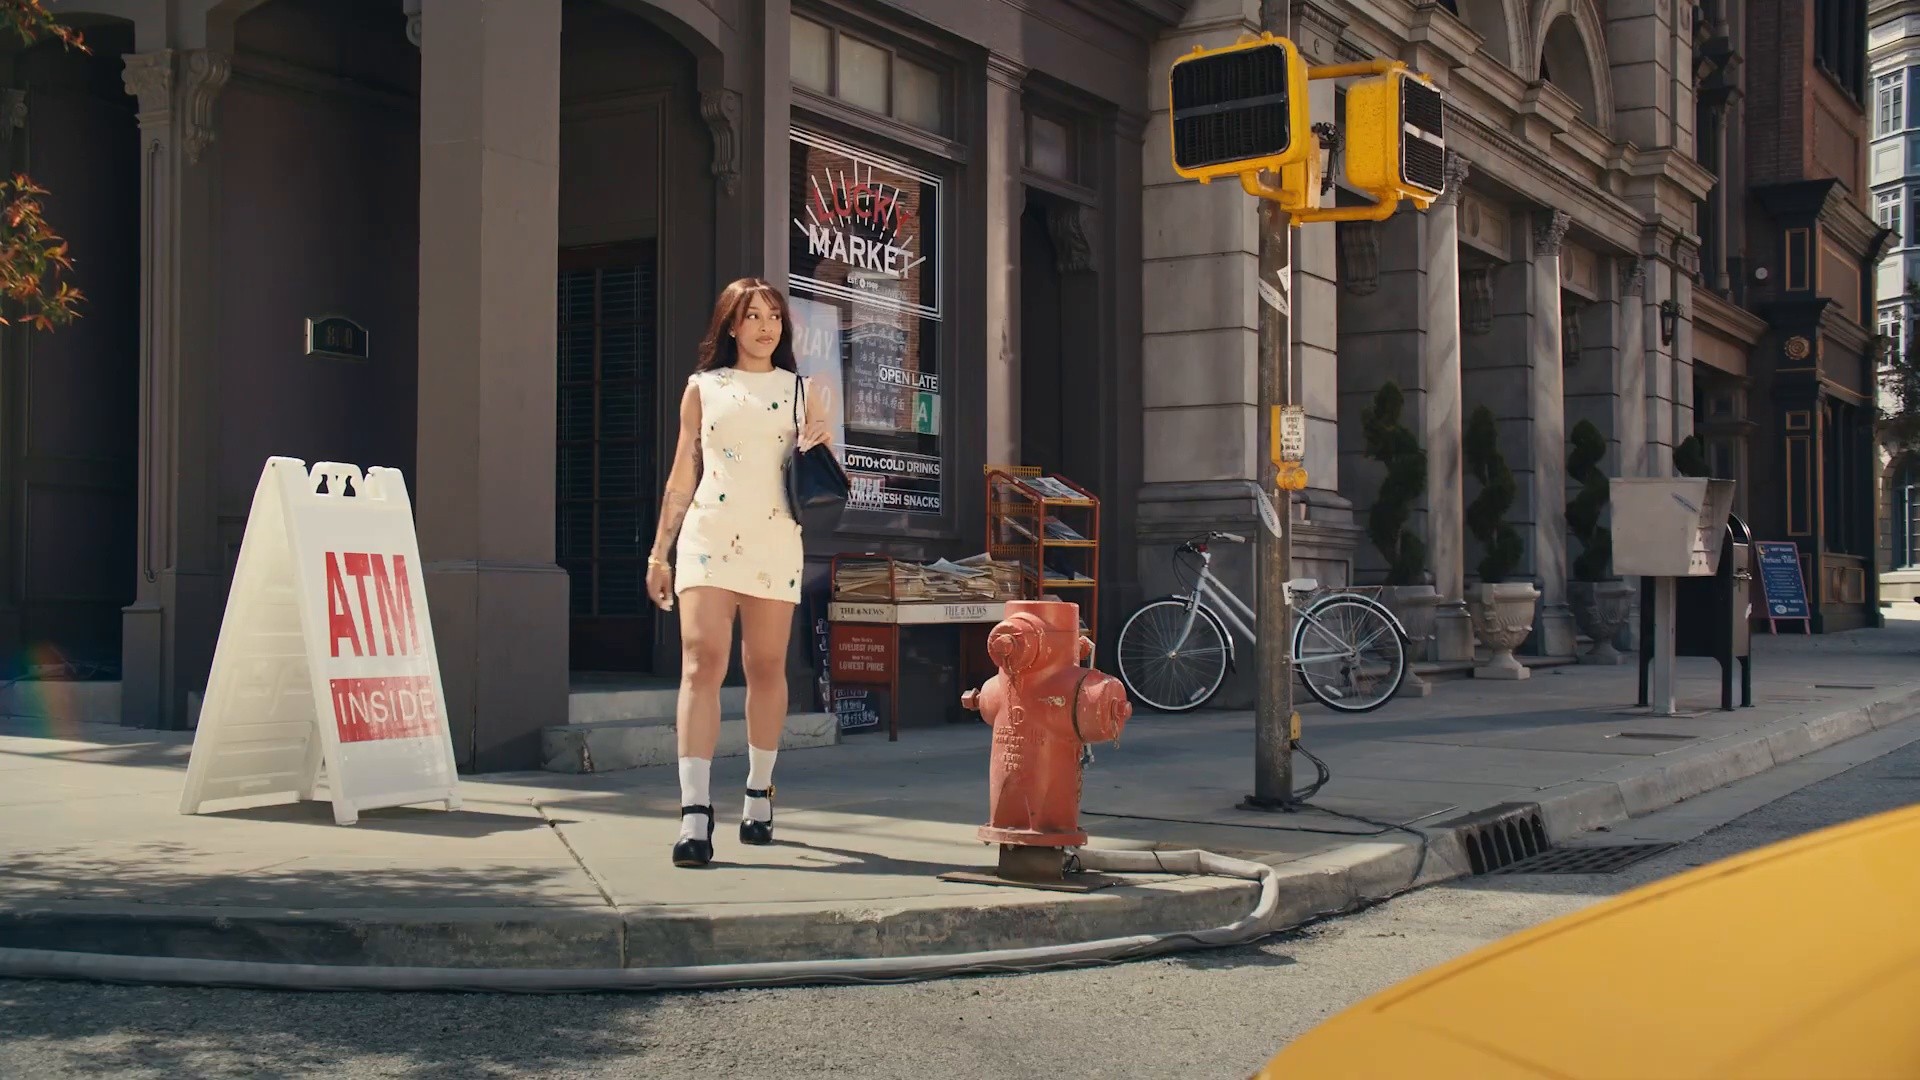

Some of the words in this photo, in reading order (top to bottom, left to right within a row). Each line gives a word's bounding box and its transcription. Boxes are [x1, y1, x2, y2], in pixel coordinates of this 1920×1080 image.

[813, 181, 911, 238] LUCKY
[808, 223, 914, 279] MARKET
[879, 367, 909, 385] OPEN
[912, 372, 938, 390] LATE
[917, 401, 928, 423] A
[842, 454, 873, 469] LOTTO
[879, 458, 905, 471] COLD
[907, 461, 940, 475] DRINKS
[871, 492, 902, 505] FRESH
[903, 495, 940, 508] SNACKS
[325, 551, 421, 658] ATM
[839, 607, 855, 615] THE
[862, 608, 885, 616] NEWS
[944, 606, 960, 616] THE
[967, 606, 987, 616] NEWS
[867, 645, 885, 653] PAPER
[839, 661, 864, 670] LOWEST
[866, 662, 885, 671] PRICE
[338, 688, 436, 726] INSIDE
